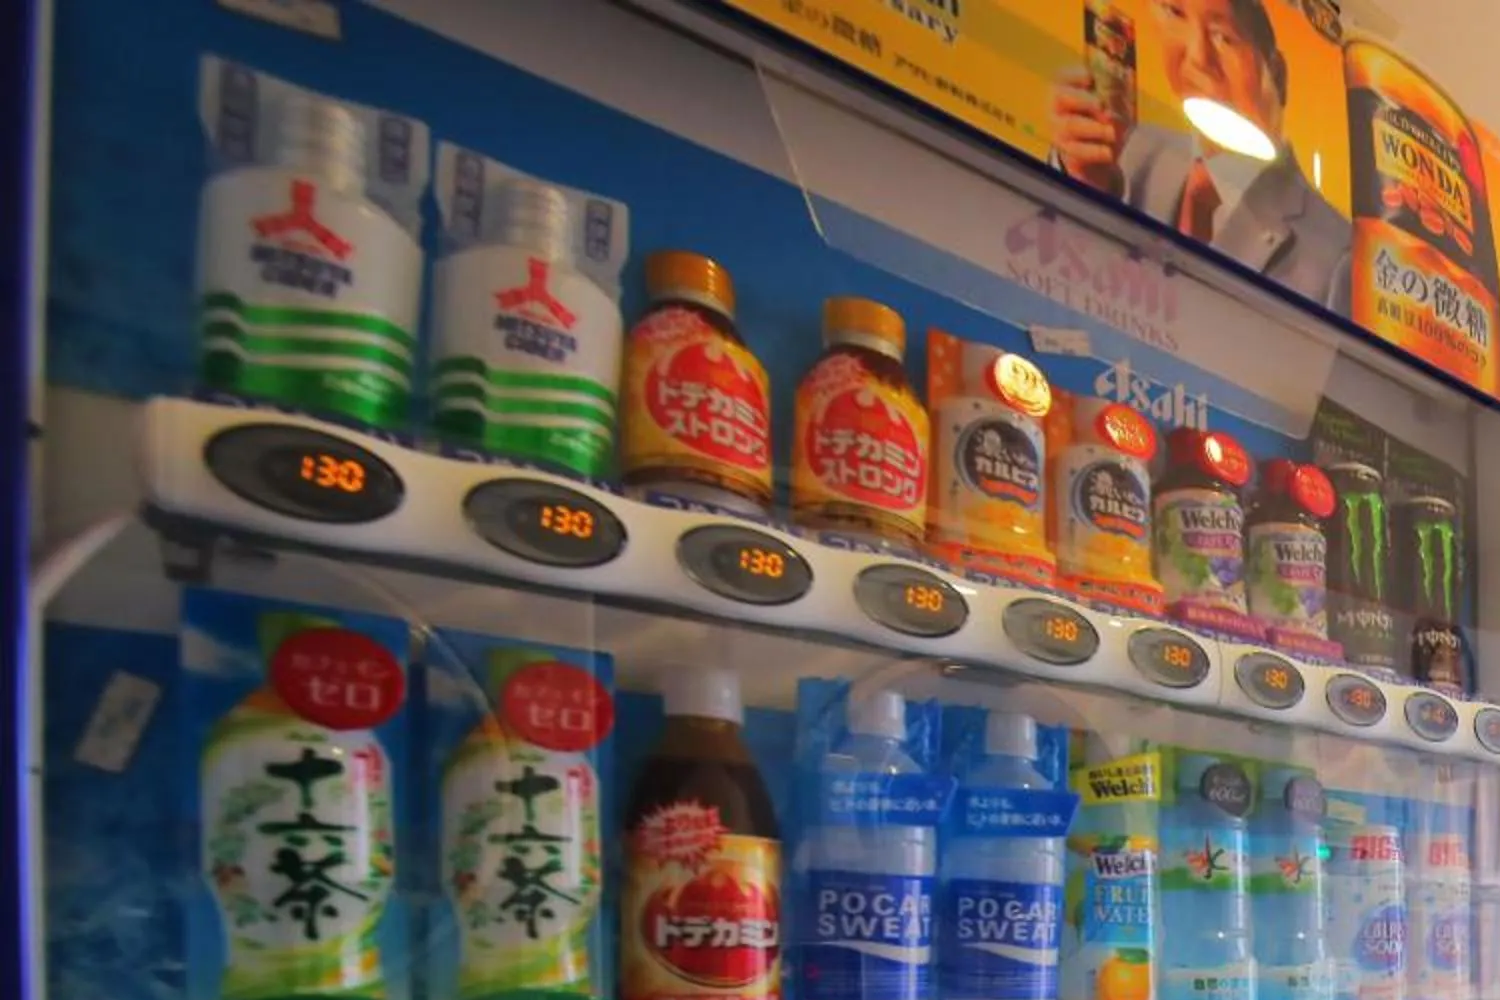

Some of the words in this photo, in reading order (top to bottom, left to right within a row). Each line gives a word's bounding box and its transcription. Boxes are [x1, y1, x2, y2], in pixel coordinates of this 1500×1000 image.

[1381, 130, 1470, 222] WONDA
[1005, 260, 1071, 304] SOFT
[1084, 294, 1180, 351] DRINKS
[1374, 248, 1488, 349] 金の微糖
[1095, 358, 1210, 432] Asahi
[813, 428, 922, 478] ドデカミン
[301, 455, 365, 493] 130
[542, 506, 594, 539] 130
[740, 550, 785, 578] 130
[1274, 542, 1325, 562] Welch
[906, 586, 944, 612] 130
[1047, 618, 1079, 641] 130
[1164, 646, 1191, 666] 130
[308, 674, 381, 712] ゼロ
[528, 702, 593, 732] ゼロ
[256, 747, 370, 941] 十六茶
[486, 765, 582, 940] 十六茶
[819, 888, 932, 918] POCAR
[957, 896, 1058, 924] POCAR
[1094, 905, 1150, 923] WATE
[655, 914, 780, 948] ドデカミン
[815, 913, 932, 941] SWEAT
[956, 919, 1058, 944] SWEAT
